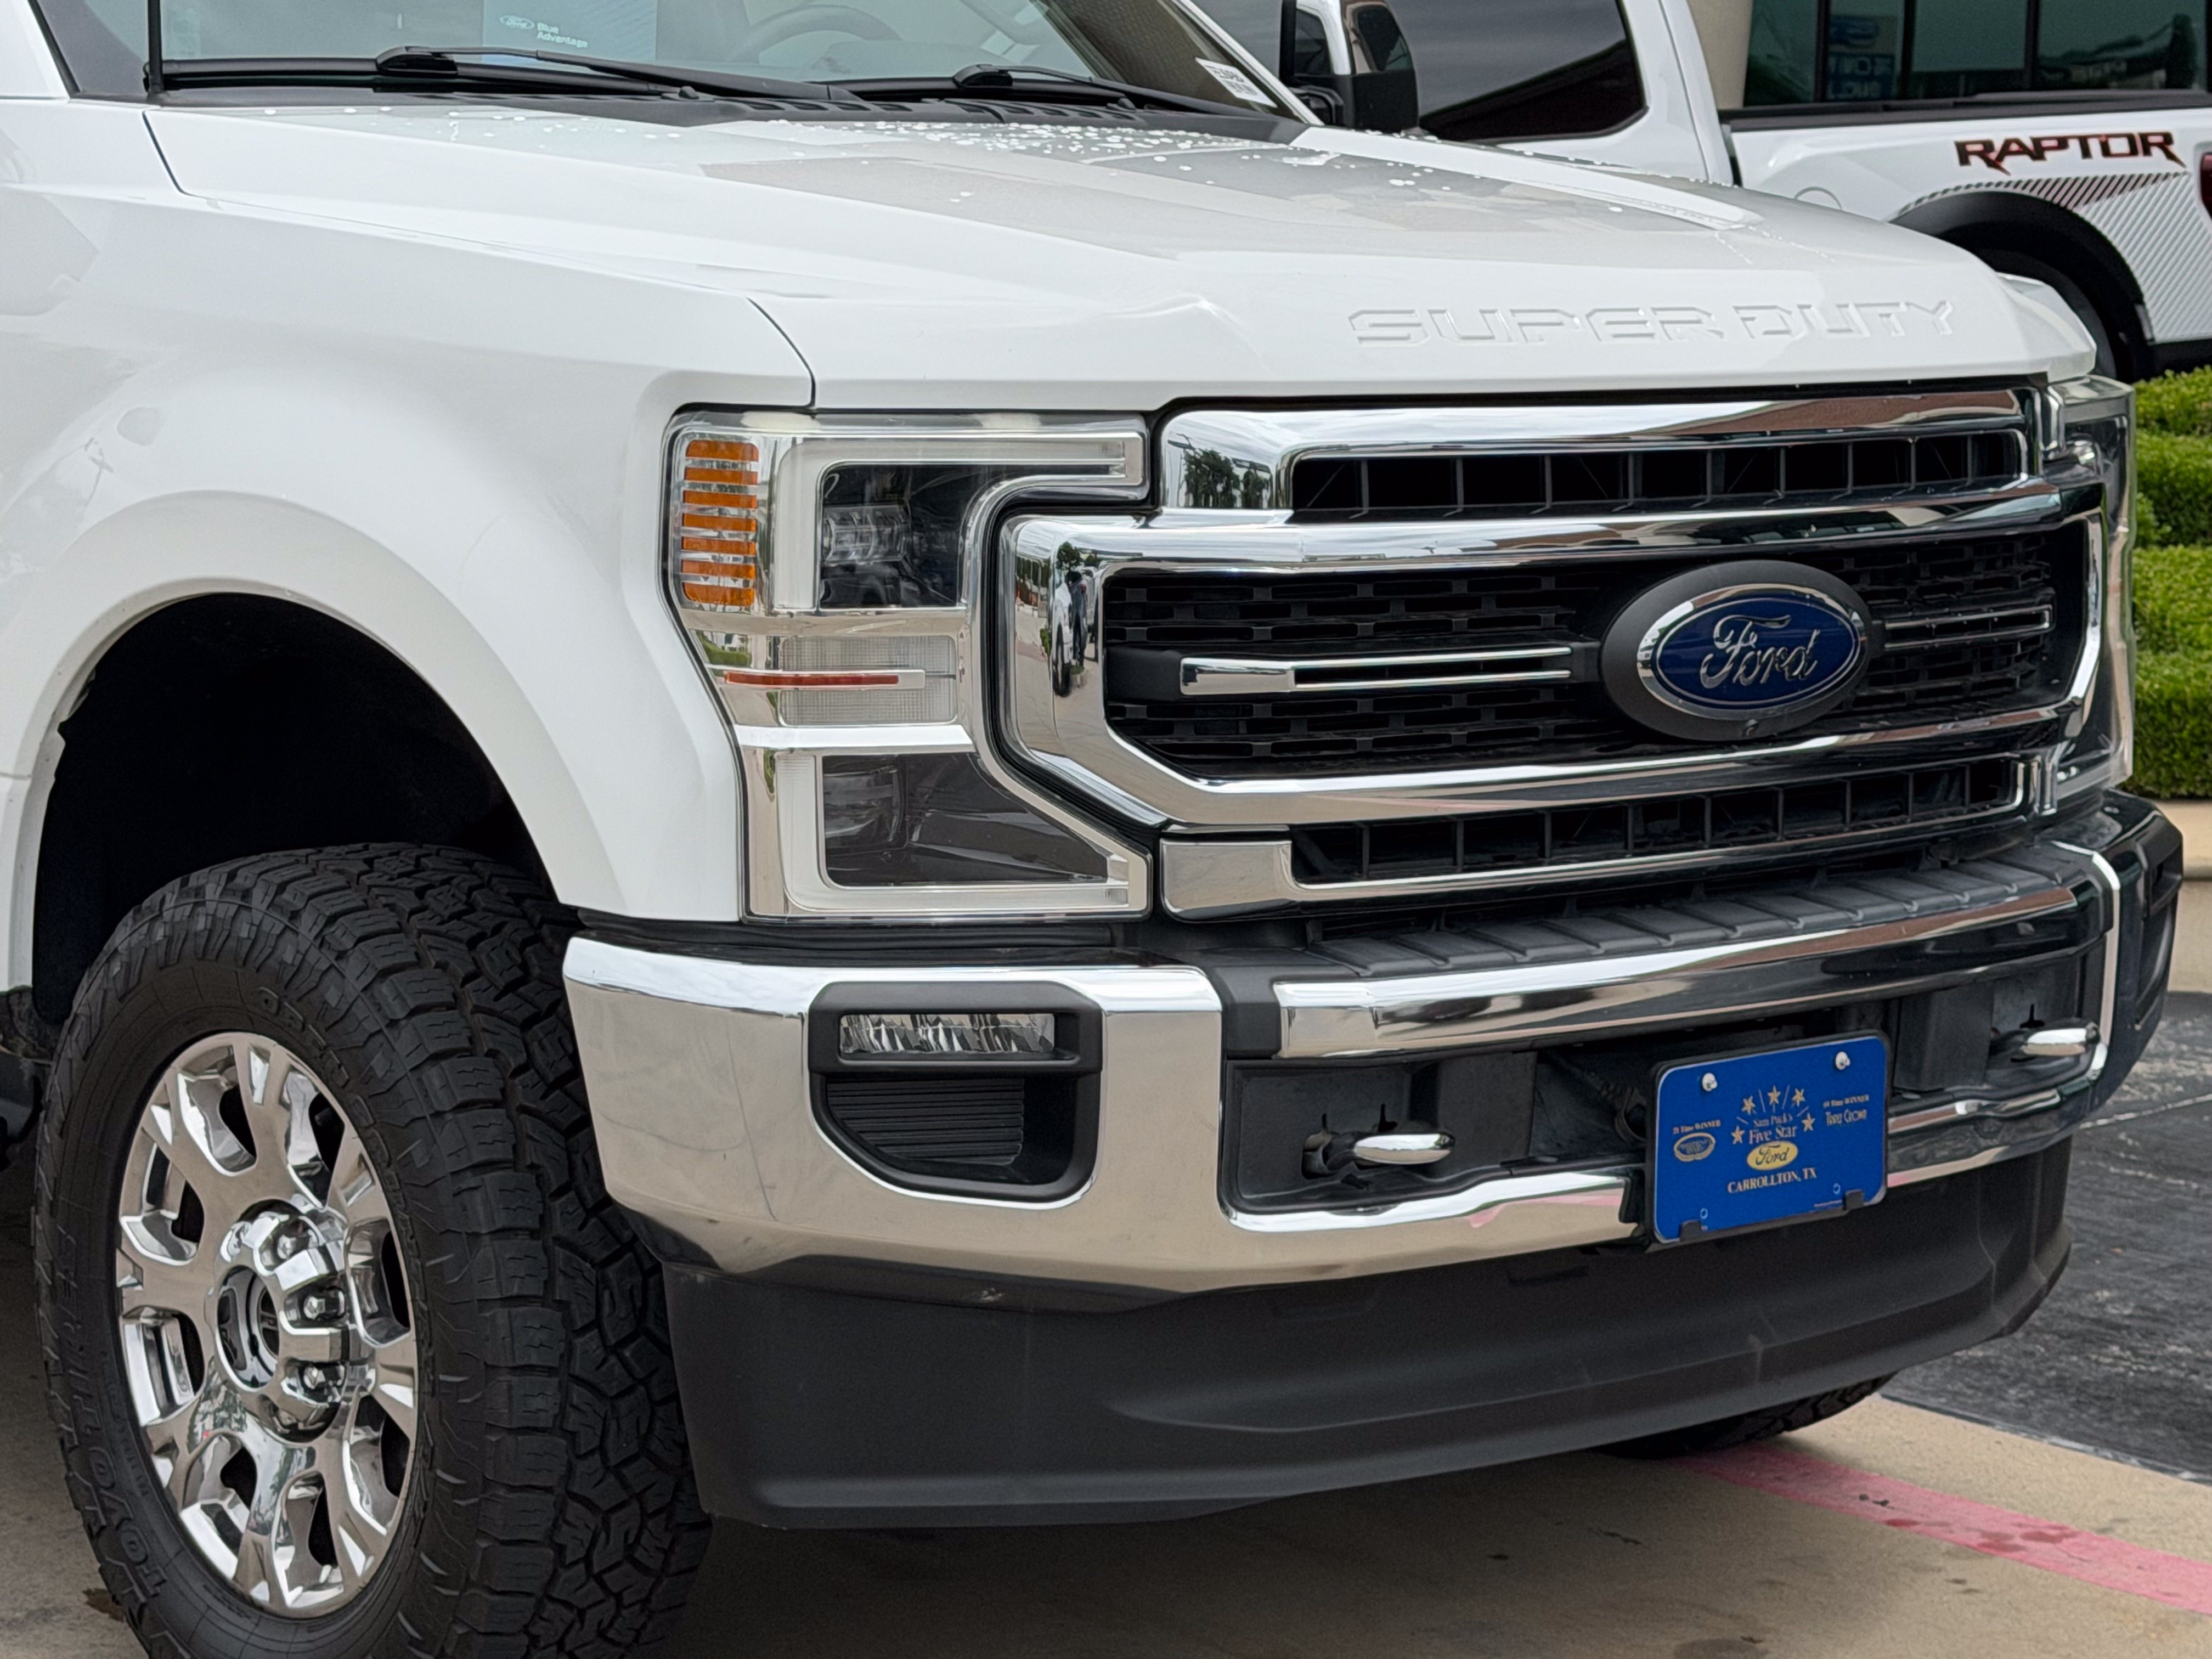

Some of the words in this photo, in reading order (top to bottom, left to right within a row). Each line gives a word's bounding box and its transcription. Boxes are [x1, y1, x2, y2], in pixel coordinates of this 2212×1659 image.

[1955, 132, 2186, 176] RAPTOR
[1348, 306, 1725, 344] SUPER
[1733, 298, 1954, 338] DUTY
[1700, 614, 1821, 689] Ford
[1748, 1127, 1773, 1145] Five
[1775, 1124, 1798, 1139] Star
[1755, 1144, 1790, 1166] Ford
[1728, 1171, 1802, 1193] CARROLLTON,
[1803, 1167, 1817, 1180] TX
